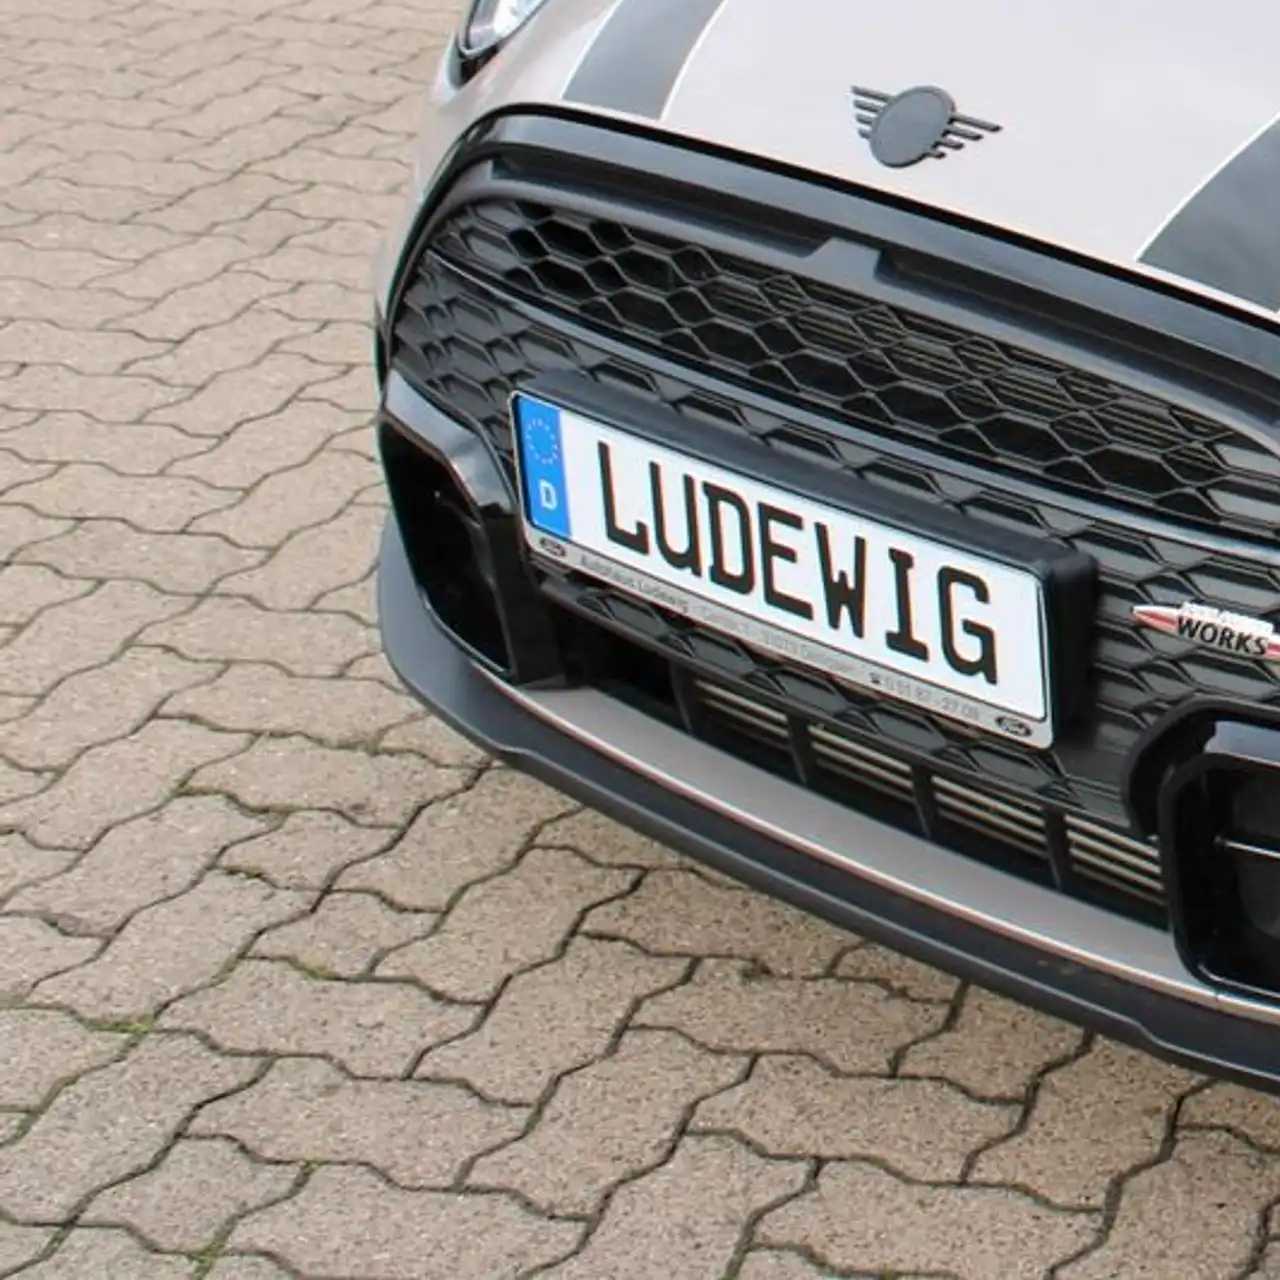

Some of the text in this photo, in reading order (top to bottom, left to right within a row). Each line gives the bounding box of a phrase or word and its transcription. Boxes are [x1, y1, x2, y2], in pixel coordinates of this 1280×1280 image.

[540, 481, 557, 510] D
[597, 441, 998, 686] LUDEWIG
[1177, 614, 1270, 655] WORKS
